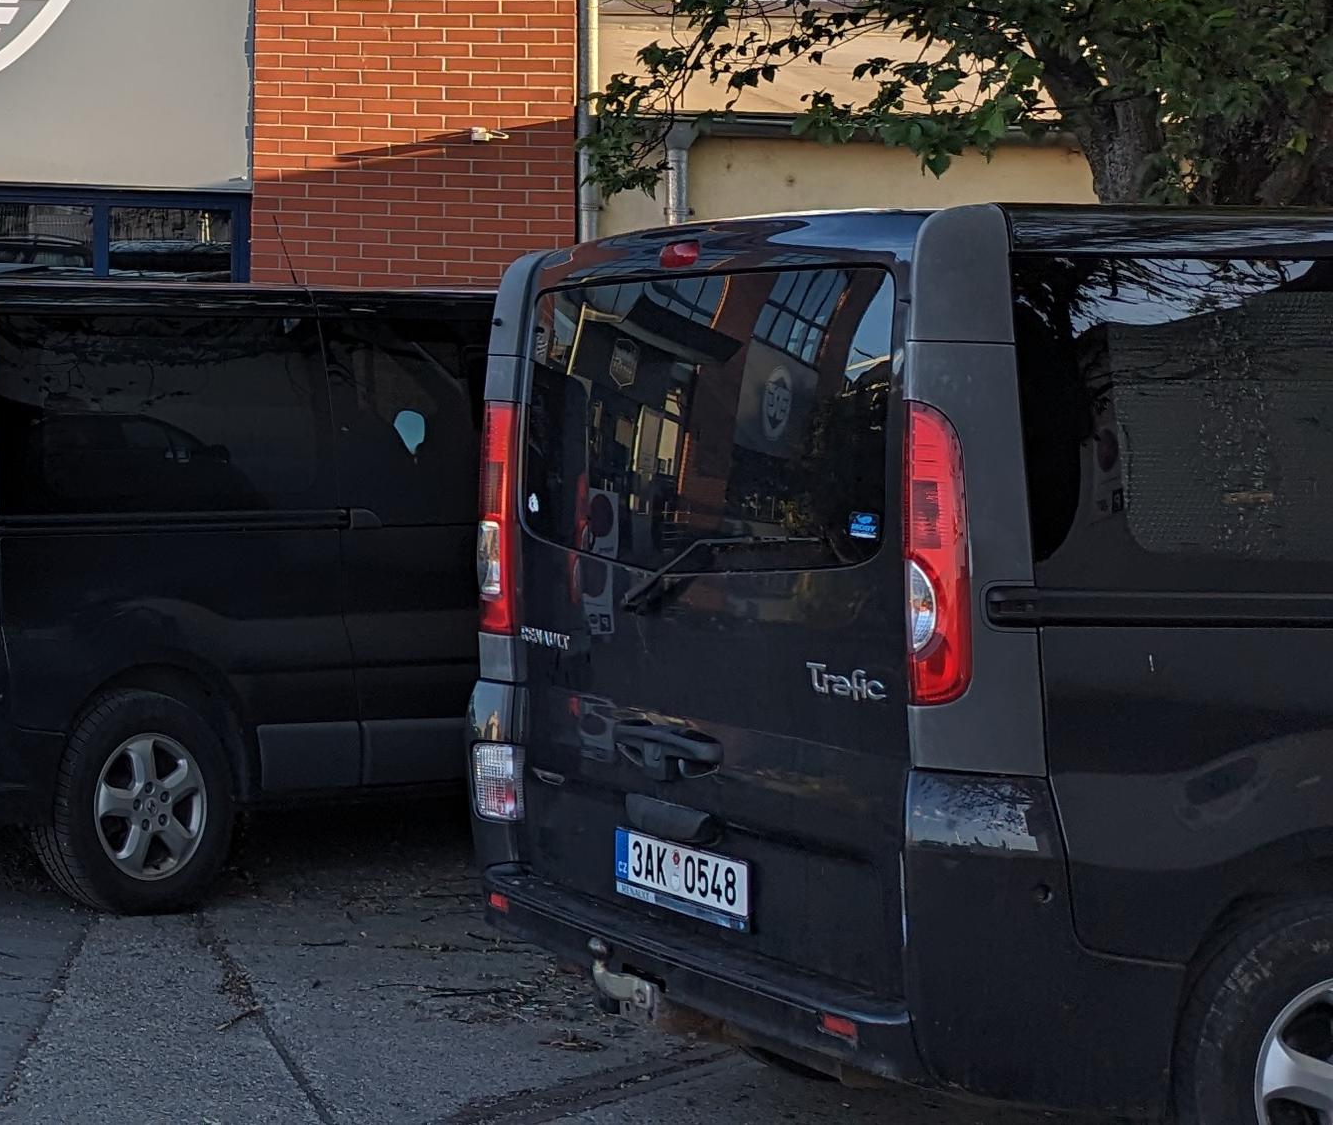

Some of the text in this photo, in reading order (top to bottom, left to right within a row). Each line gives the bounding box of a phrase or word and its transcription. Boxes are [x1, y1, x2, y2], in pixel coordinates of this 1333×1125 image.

[805, 661, 887, 702] Trafic
[617, 840, 737, 906] CZ 3AK 0548
